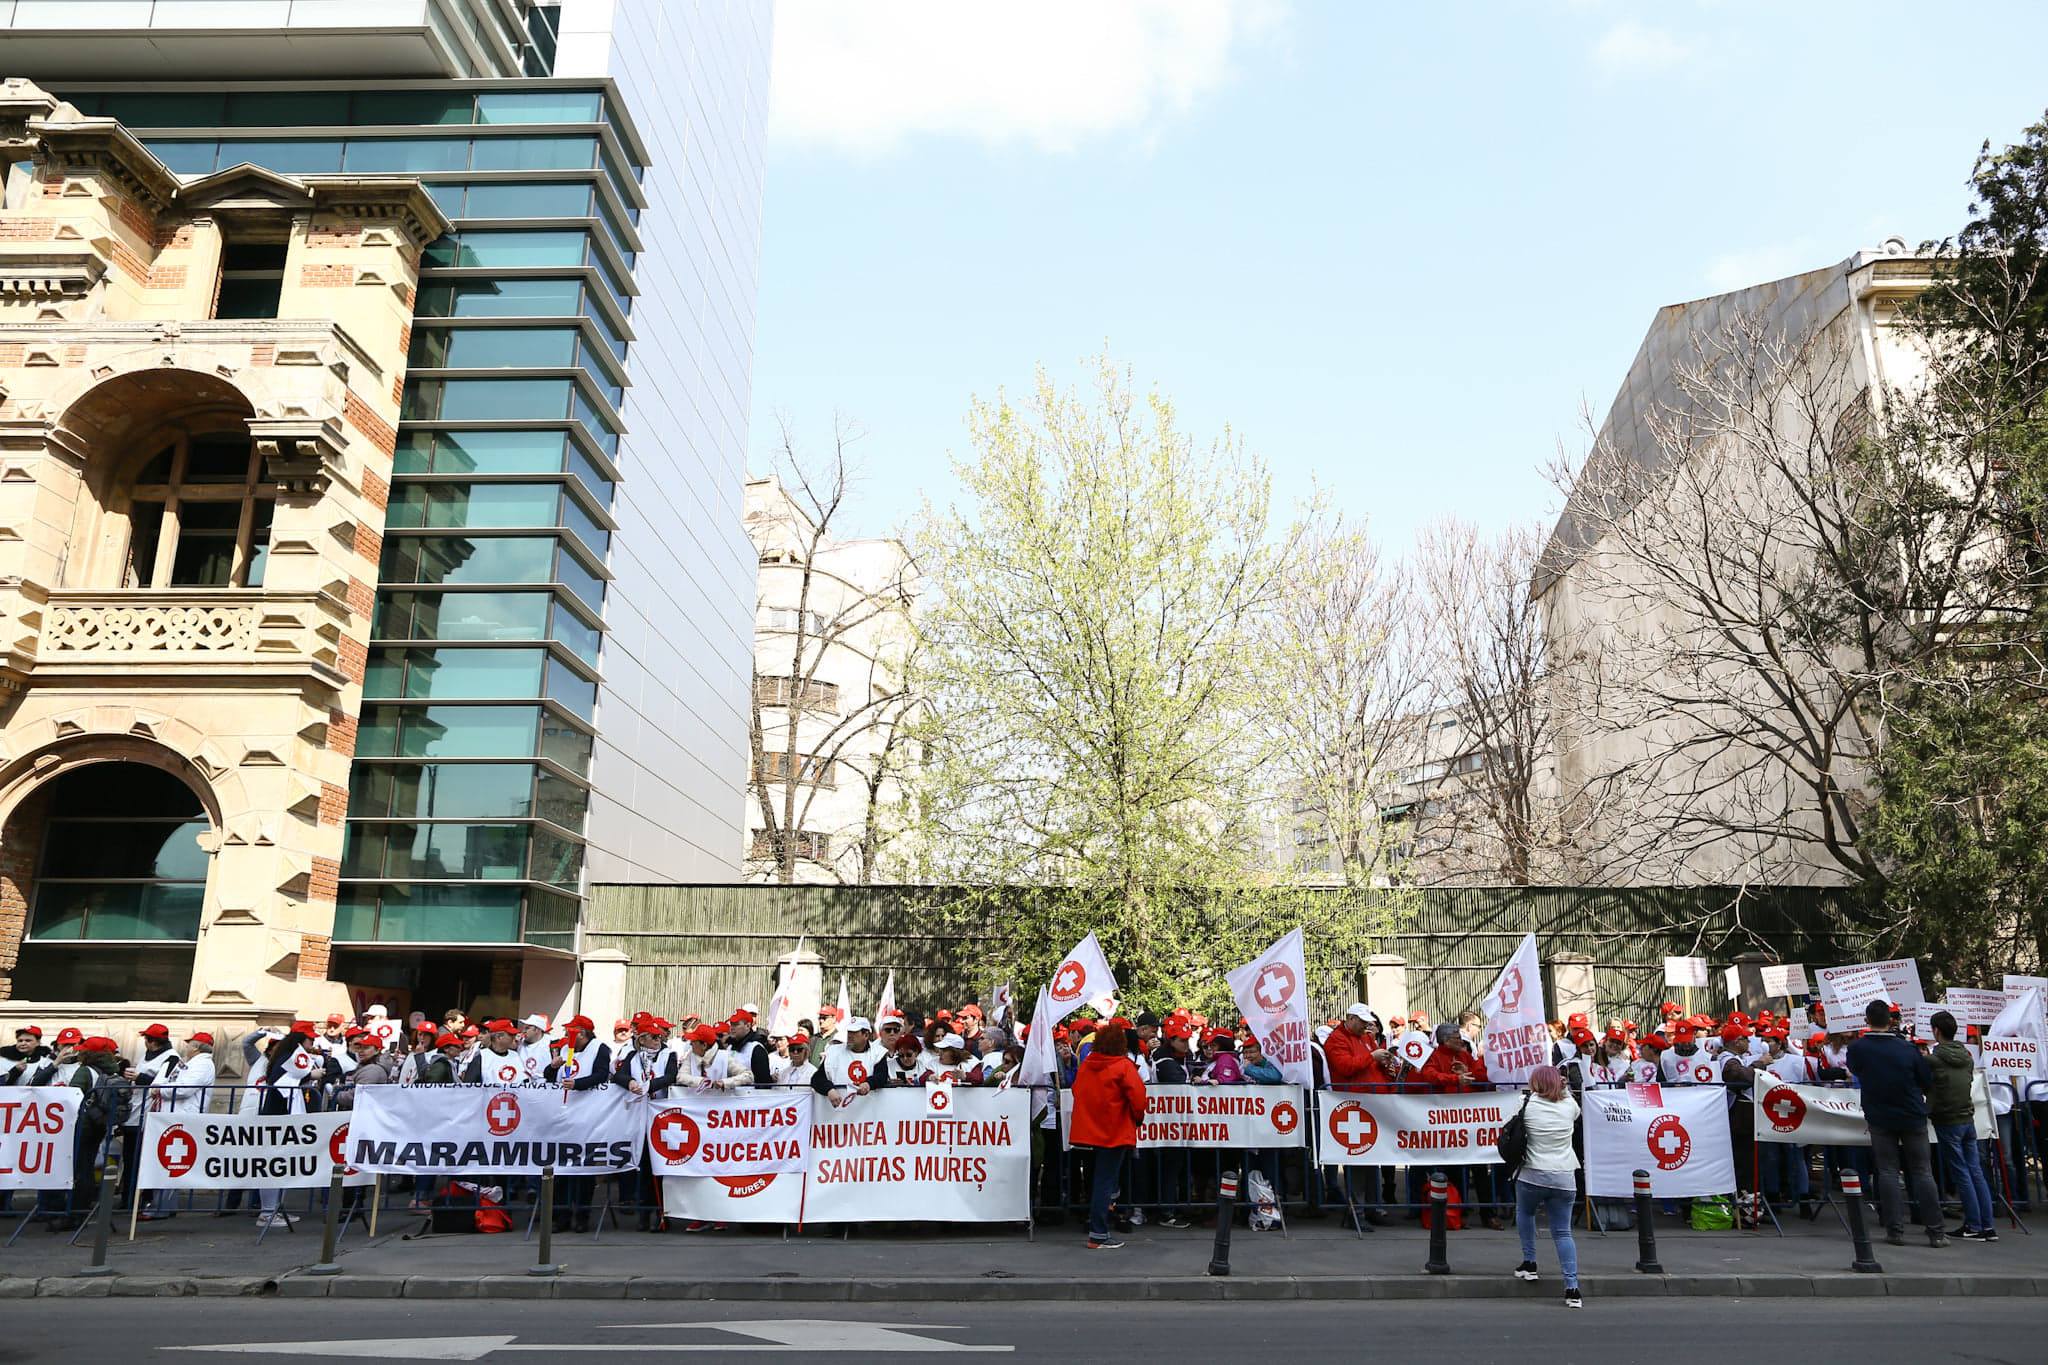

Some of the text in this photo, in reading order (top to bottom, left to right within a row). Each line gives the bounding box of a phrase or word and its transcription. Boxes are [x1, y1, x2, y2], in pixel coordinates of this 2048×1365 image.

[1983, 1040, 2036, 1053] SANITAS
[1198, 1096, 1265, 1115] SANITAS
[1428, 1107, 1503, 1125] SINDICATUL
[707, 1107, 798, 1129] SANITAS
[205, 1124, 318, 1146] SANITAS
[808, 1115, 1012, 1155] NIUNEA JUDEȚEANĂ
[1138, 1122, 1230, 1141] CONSTANTA
[1397, 1127, 1504, 1149] SANITAS GA
[702, 1140, 801, 1163] SUCEAVA
[204, 1155, 318, 1178] GIURGIU
[817, 1156, 987, 1192] SANITAS MUREȘ
